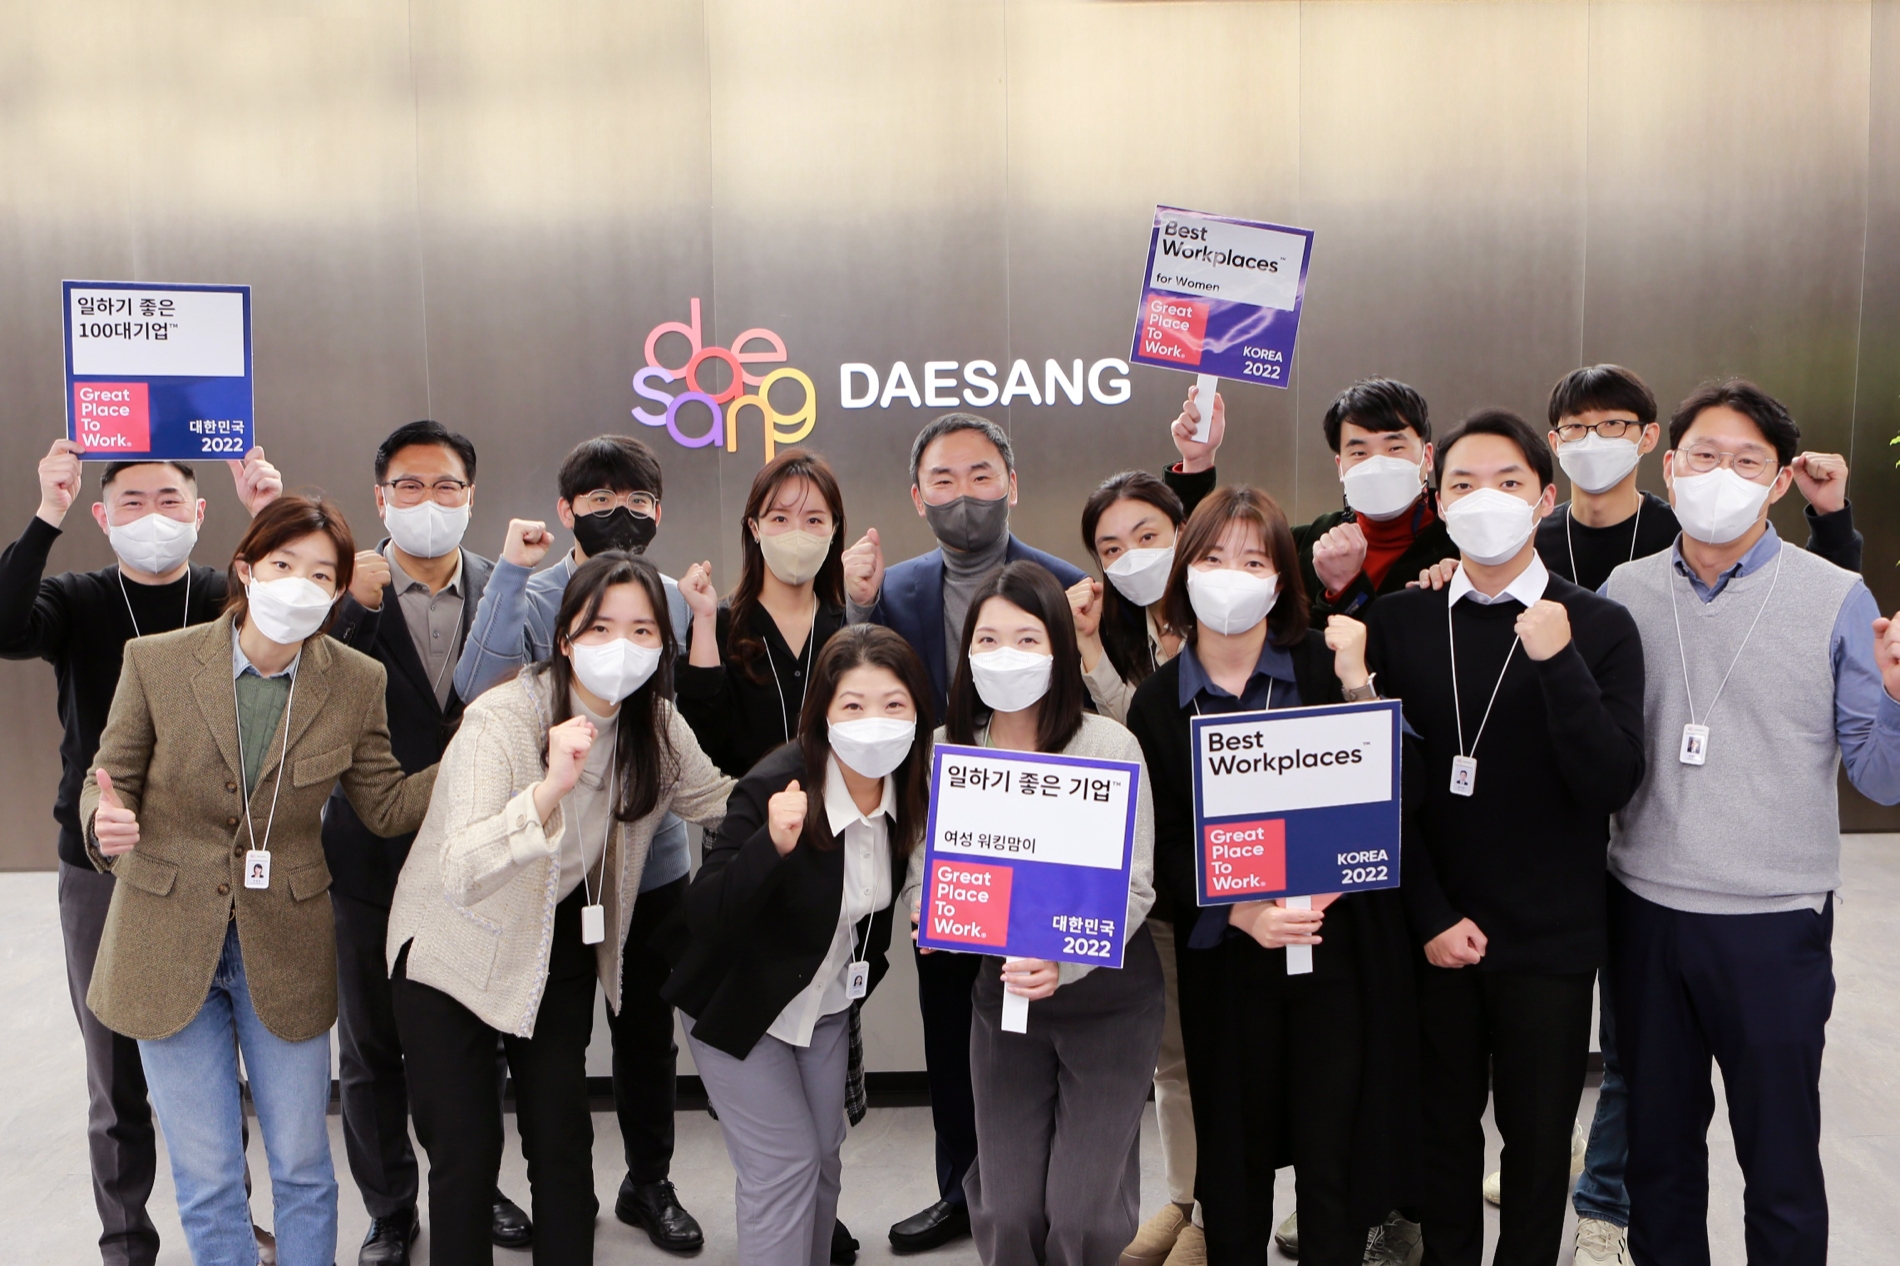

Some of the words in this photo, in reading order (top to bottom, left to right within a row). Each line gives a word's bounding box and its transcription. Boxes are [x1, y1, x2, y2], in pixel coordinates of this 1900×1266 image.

[1164, 220, 1207, 241] Best
[1156, 272, 1172, 285] for
[1175, 275, 1220, 292] Women
[77, 296, 132, 316] 일하기
[139, 298, 176, 317] 좋은
[1150, 300, 1193, 318] Great
[1149, 314, 1190, 331] Place
[1147, 326, 1163, 340] To
[1242, 346, 1283, 363] KOREA
[1243, 361, 1281, 379] 2022
[839, 357, 1132, 409] DAESANG
[79, 387, 130, 402] Great
[81, 402, 130, 417] Place
[81, 418, 100, 431] To
[189, 420, 245, 434] 대한민국
[201, 438, 244, 452] 2022
[1208, 731, 1264, 752] Best
[947, 765, 1011, 793] 일하기
[1018, 771, 1061, 797] 좋은
[944, 830, 973, 848] 여성
[977, 833, 1036, 854] 워킹맘이
[1210, 827, 1265, 844] Great
[1211, 844, 1264, 859] Place
[1337, 849, 1389, 866] KOREA
[937, 866, 992, 886] Great
[1211, 861, 1233, 875] To
[1341, 865, 1389, 884] 2022
[937, 884, 990, 903] Place
[935, 900, 956, 917] To
[1052, 915, 1116, 937] 대한민국
[1062, 936, 1112, 958] 2022
